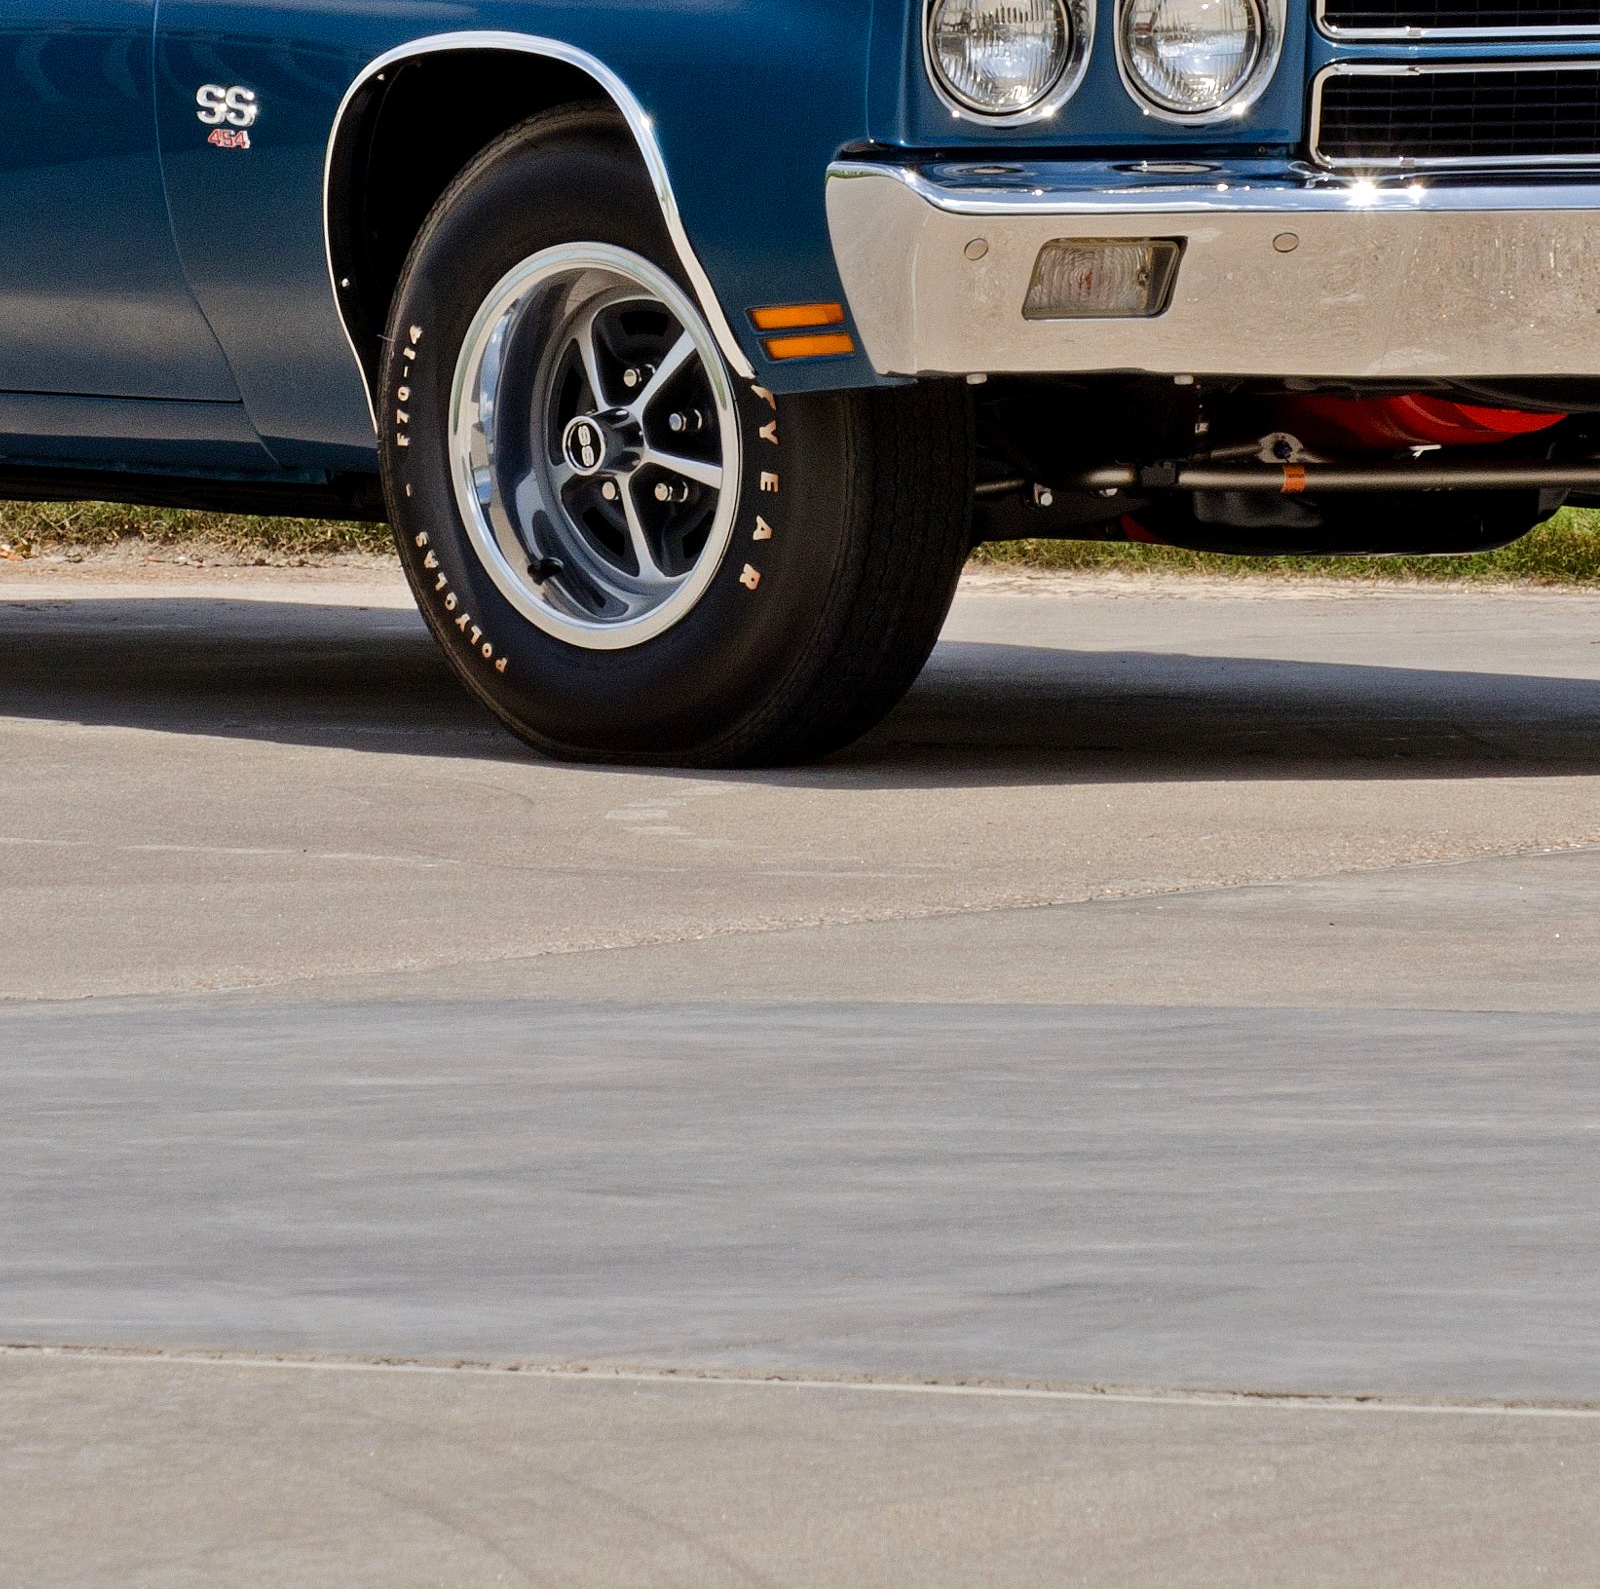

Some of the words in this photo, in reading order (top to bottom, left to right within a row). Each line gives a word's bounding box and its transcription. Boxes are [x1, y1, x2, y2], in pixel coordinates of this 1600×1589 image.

[196, 84, 258, 127] SS
[207, 128, 251, 149] 454
[415, 531, 508, 674] POLYGLAS
